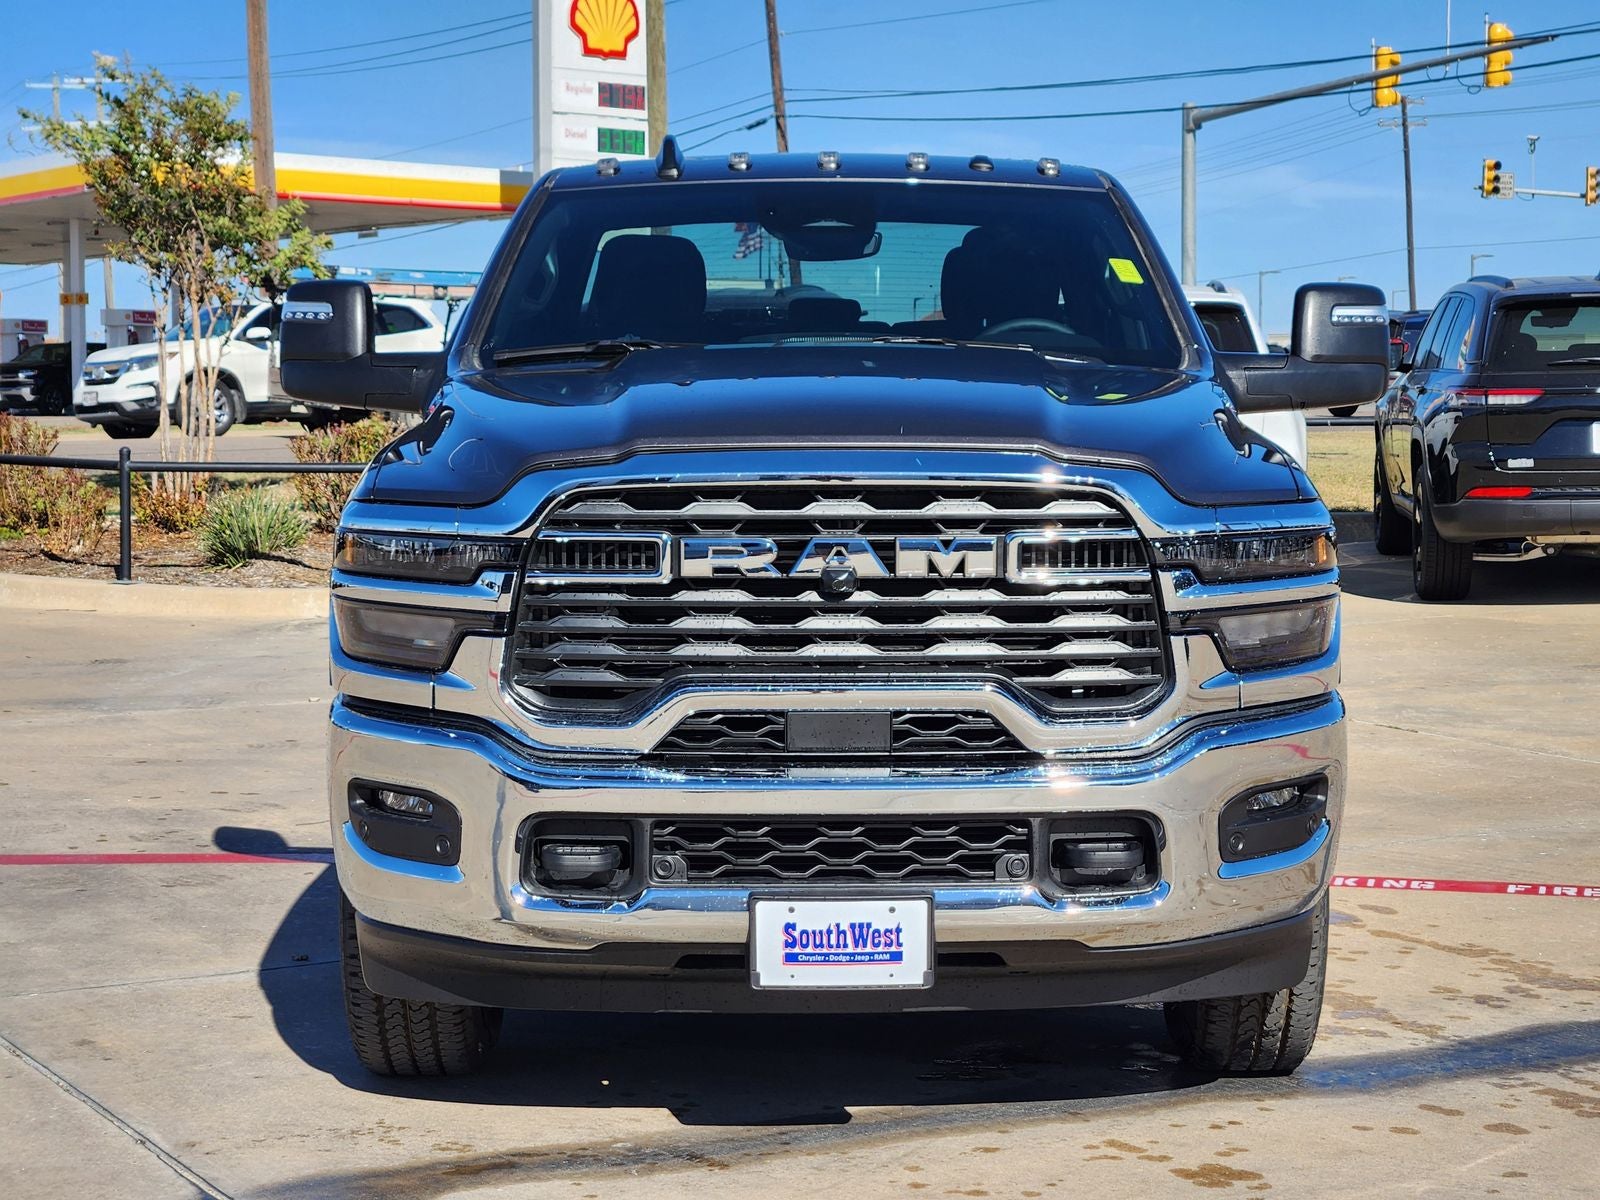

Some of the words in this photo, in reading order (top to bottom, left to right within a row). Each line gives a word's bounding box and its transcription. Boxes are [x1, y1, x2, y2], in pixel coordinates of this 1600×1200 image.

[679, 536, 998, 579] RAM
[797, 953, 825, 963] Chrysler
[829, 953, 850, 963] Dodge
[854, 953, 870, 963] Jeep
[873, 952, 890, 962] RAM
